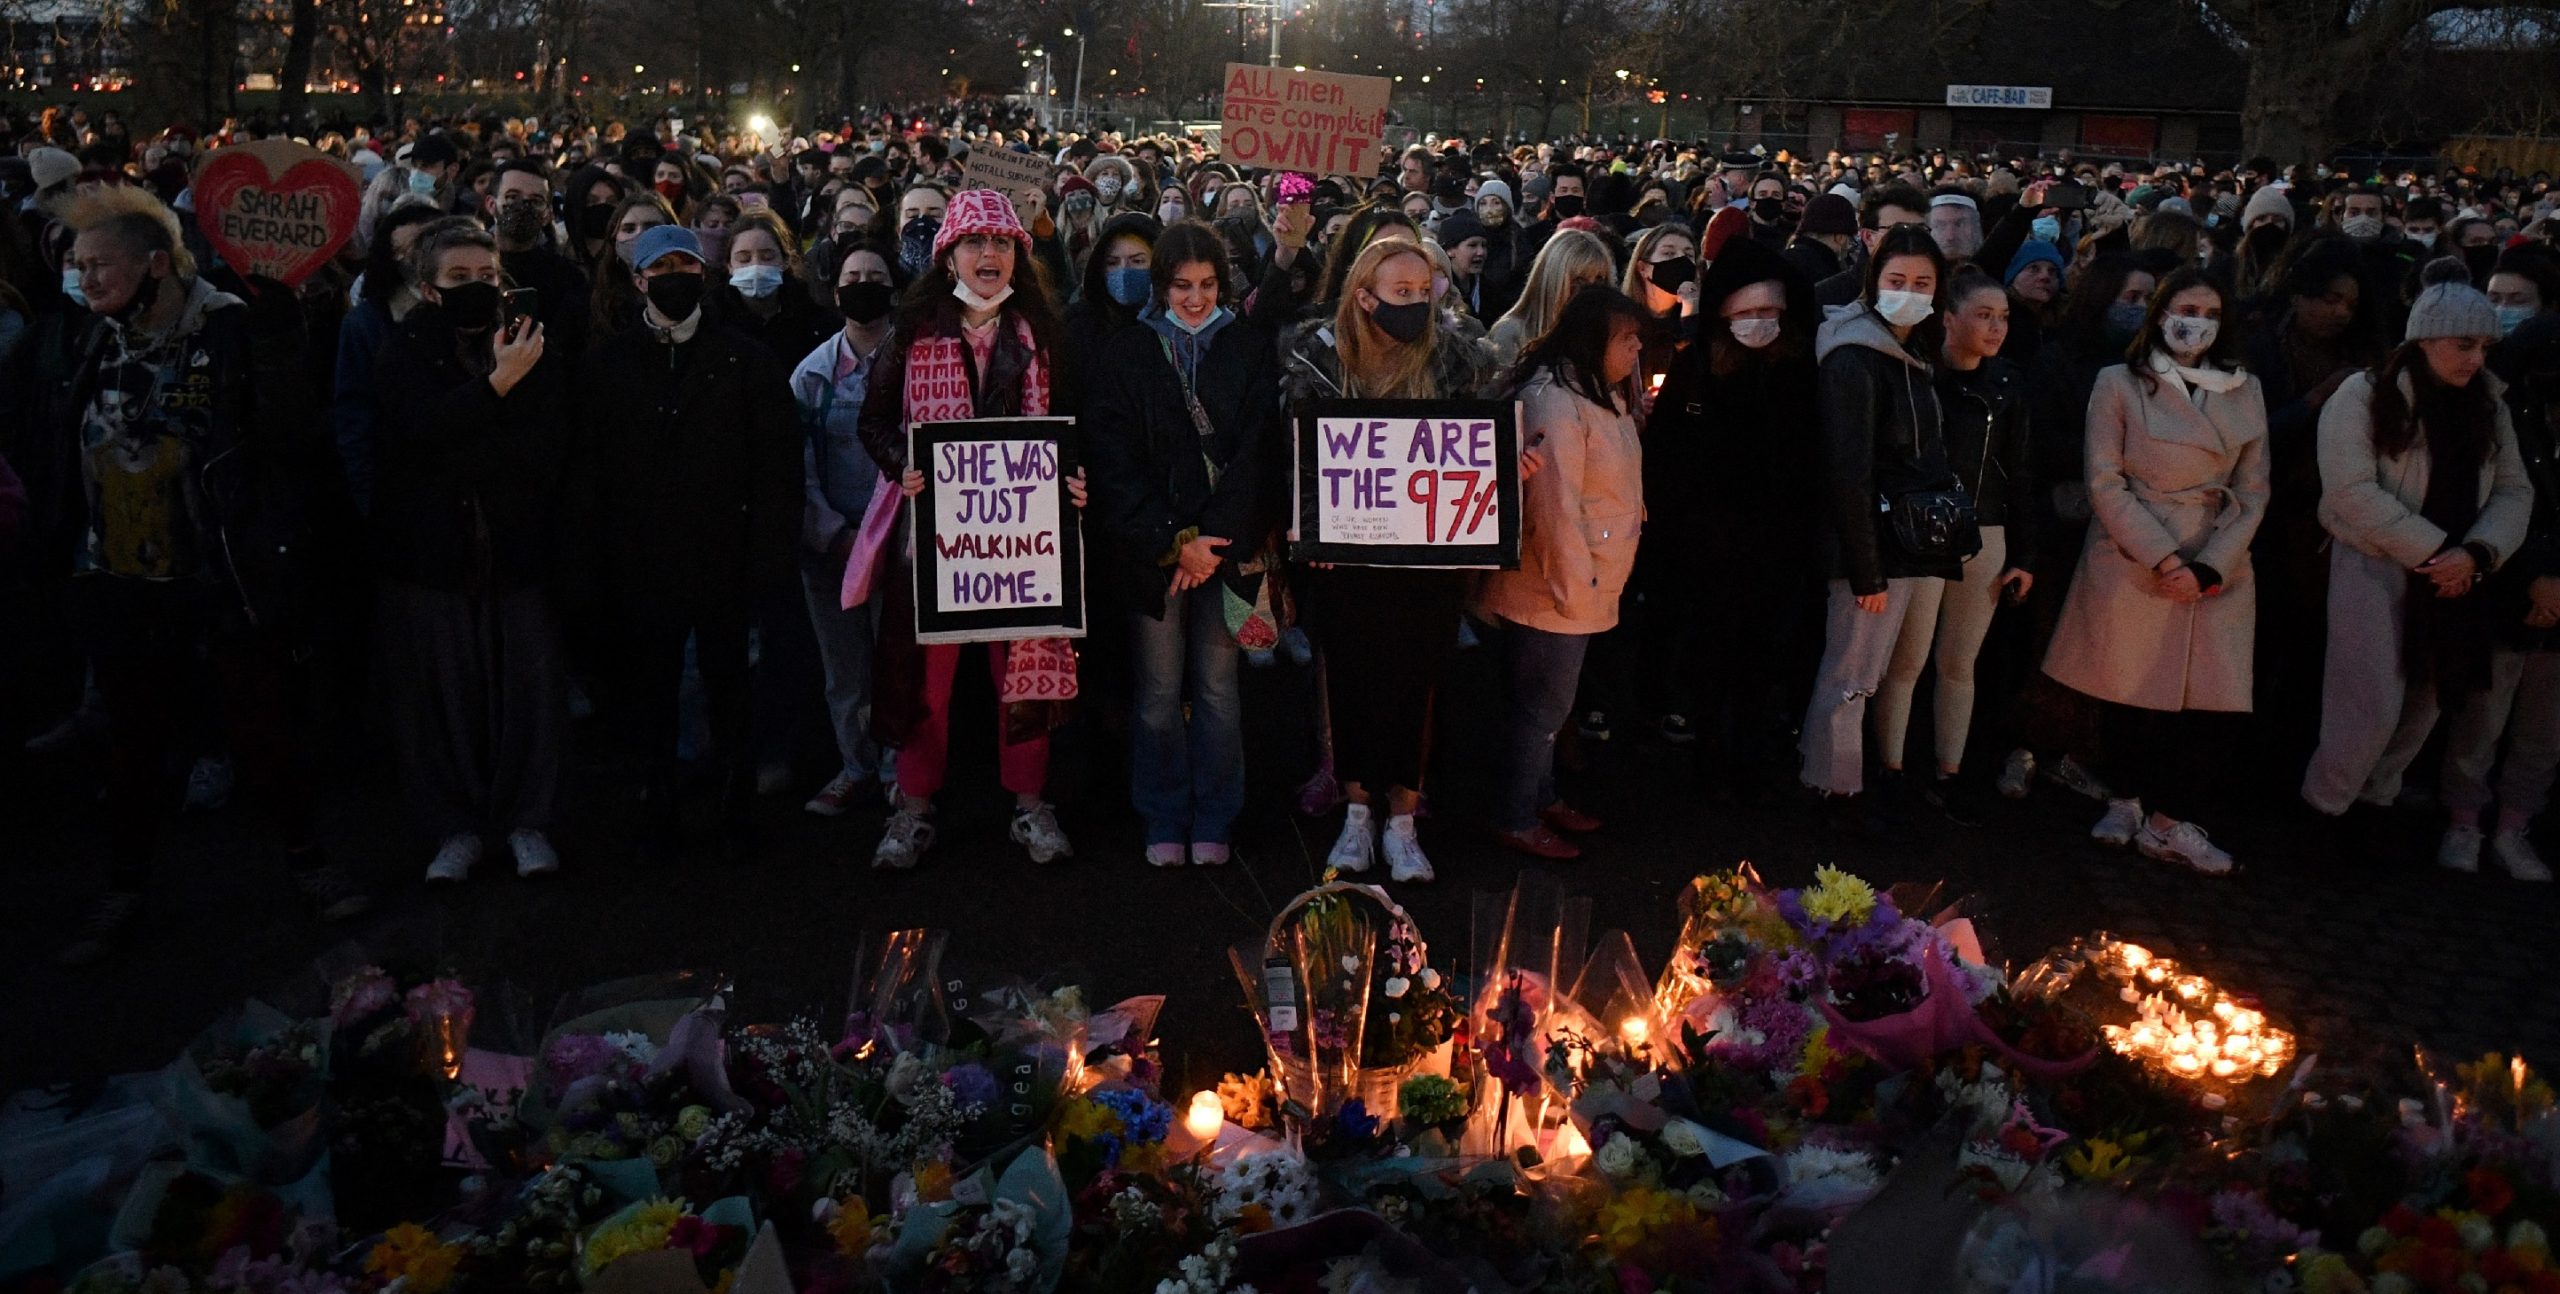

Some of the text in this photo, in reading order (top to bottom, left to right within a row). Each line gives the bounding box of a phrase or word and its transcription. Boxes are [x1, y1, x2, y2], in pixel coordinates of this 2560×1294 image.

[1287, 79, 1344, 105] men
[1224, 103, 1388, 139] are complicit
[1007, 171, 1041, 186] SURVIVE
[1019, 158, 1044, 169] FEAR
[239, 189, 319, 221] SARAH
[224, 215, 327, 248] EVERARD
[1323, 418, 1492, 467] WE ARE
[937, 440, 1057, 485] SHE WAS
[956, 485, 1037, 524] JUST
[1322, 467, 1498, 543] THE 97%
[936, 531, 1055, 560] WALKING
[953, 570, 1052, 604] HOME.
